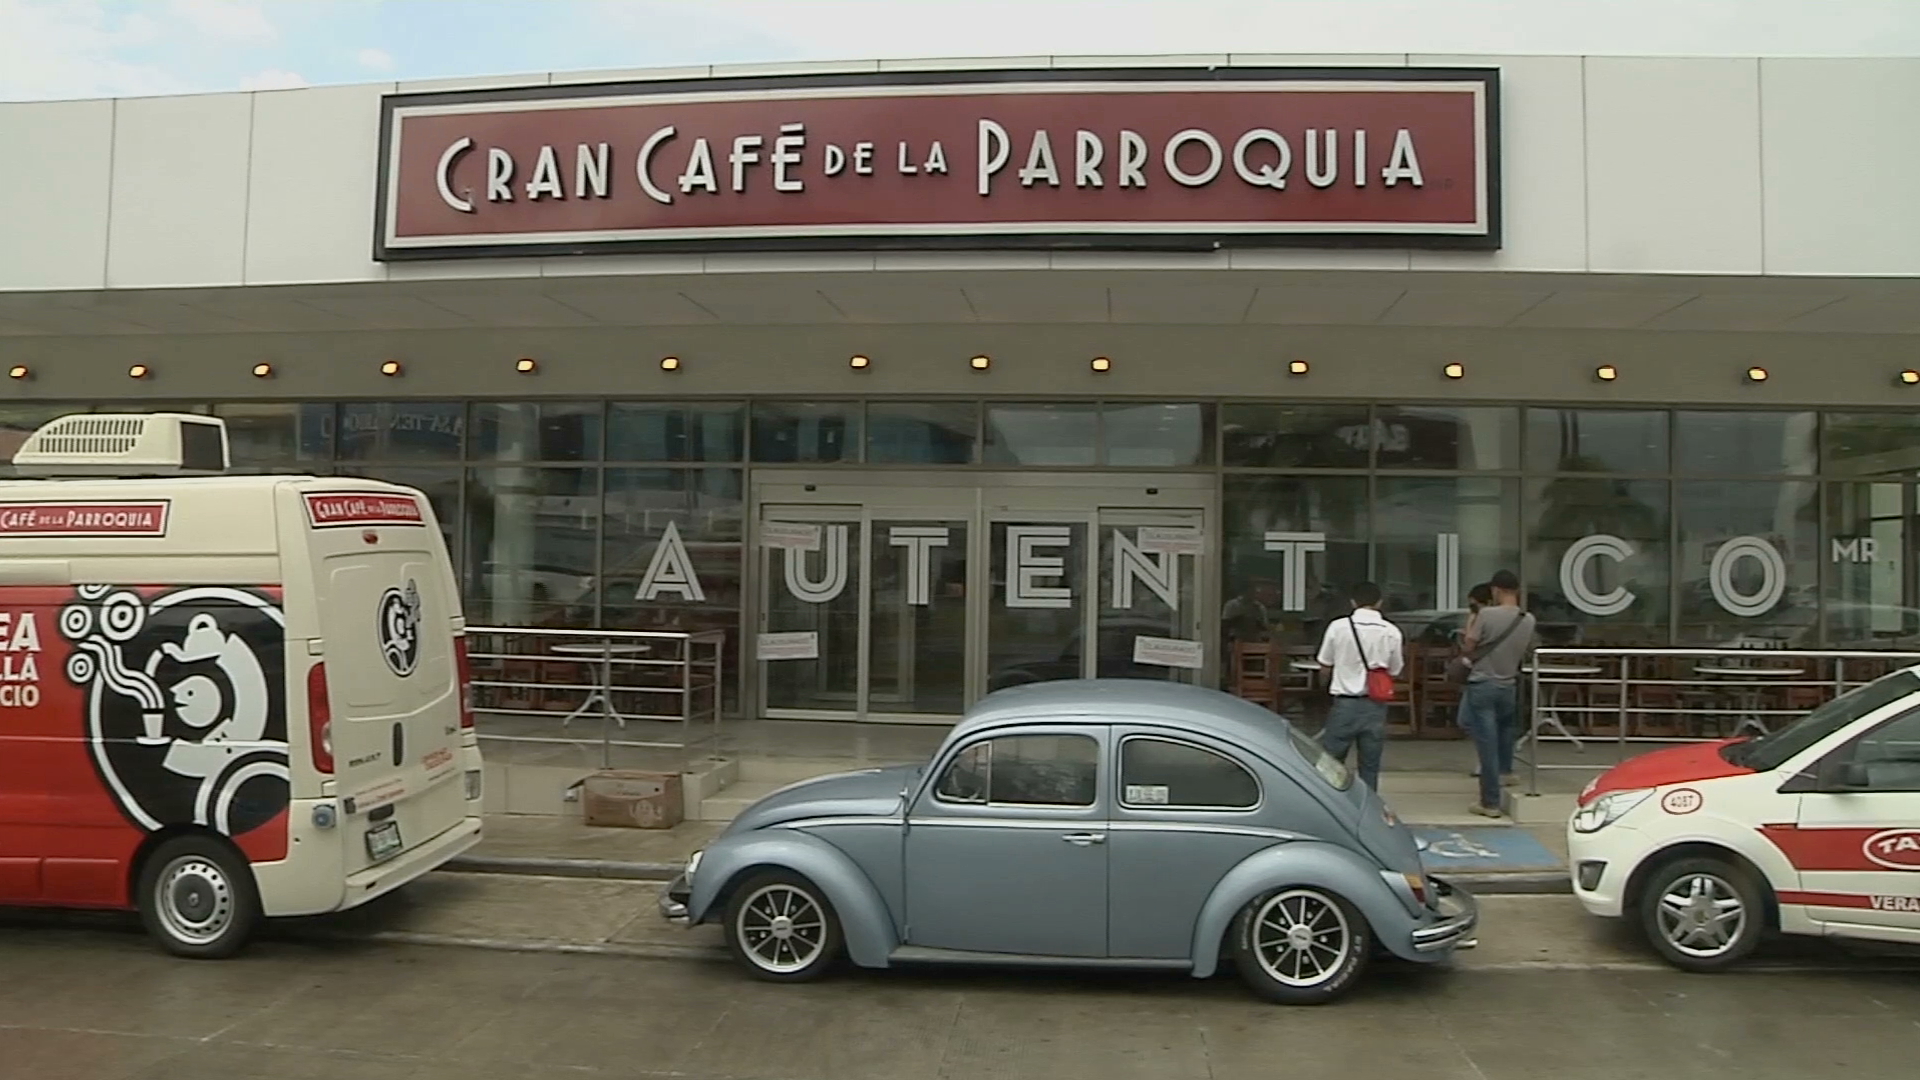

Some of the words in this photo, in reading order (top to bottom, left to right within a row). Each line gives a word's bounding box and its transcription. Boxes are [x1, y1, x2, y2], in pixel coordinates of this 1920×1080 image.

[636, 122, 806, 204] CAFÉ
[823, 142, 874, 176] DE
[898, 141, 949, 174] LA
[978, 118, 1424, 197] PARROQUIA
[1, 510, 37, 529] CAFÉ
[67, 511, 153, 528] PARROQUIA
[1832, 543, 1880, 562] MR
